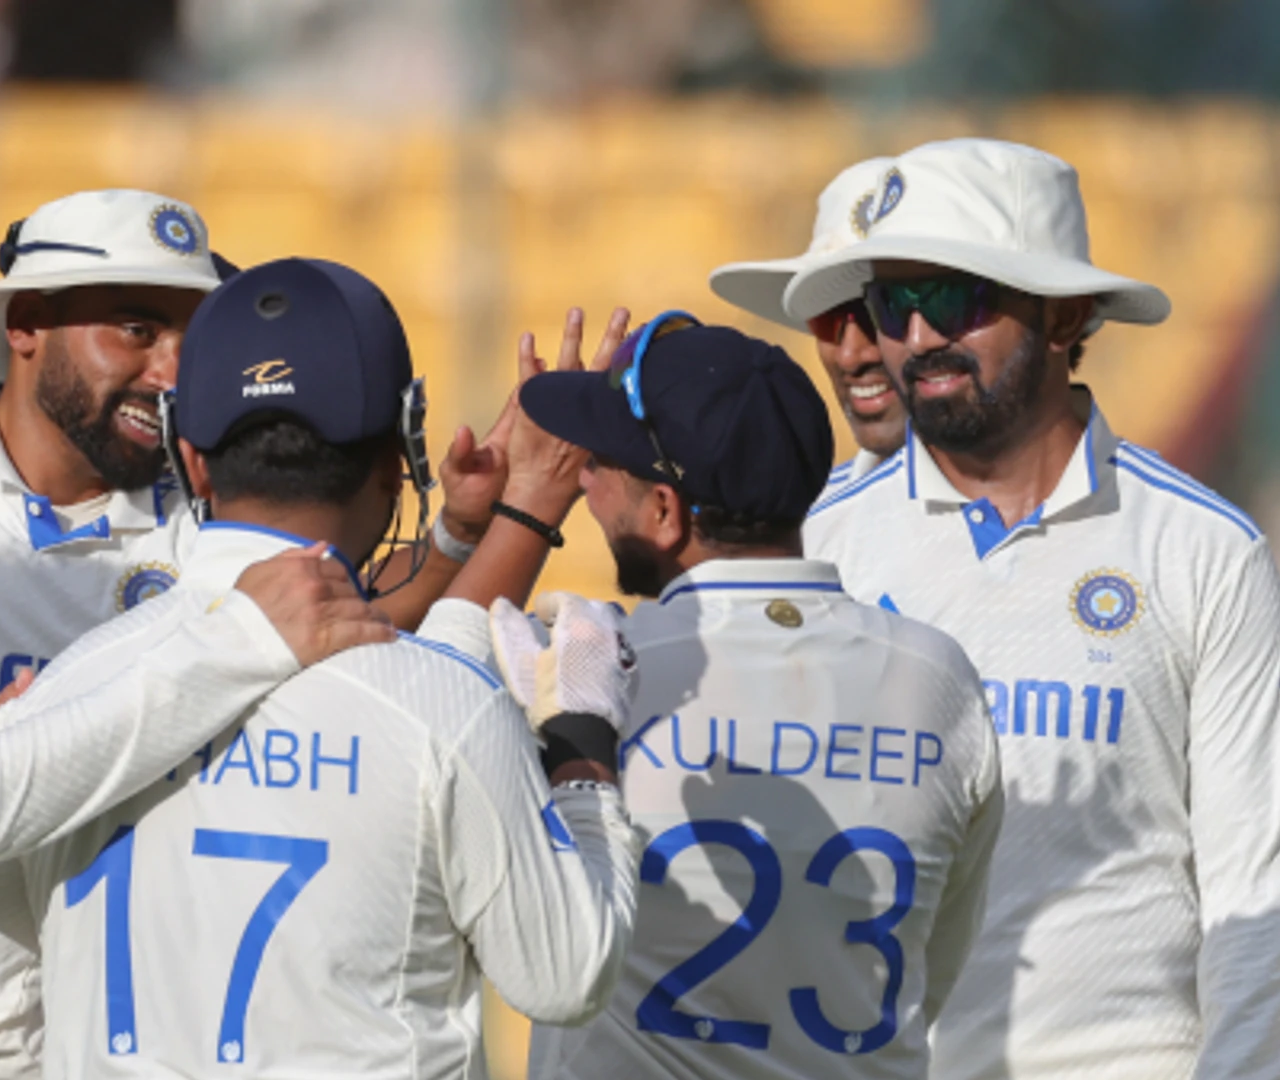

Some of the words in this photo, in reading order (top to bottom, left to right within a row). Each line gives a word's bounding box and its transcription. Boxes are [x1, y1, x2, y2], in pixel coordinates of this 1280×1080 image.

[618, 714, 944, 787] KULDEEP
[64, 826, 330, 1065] 17
[636, 820, 917, 1055] 23
